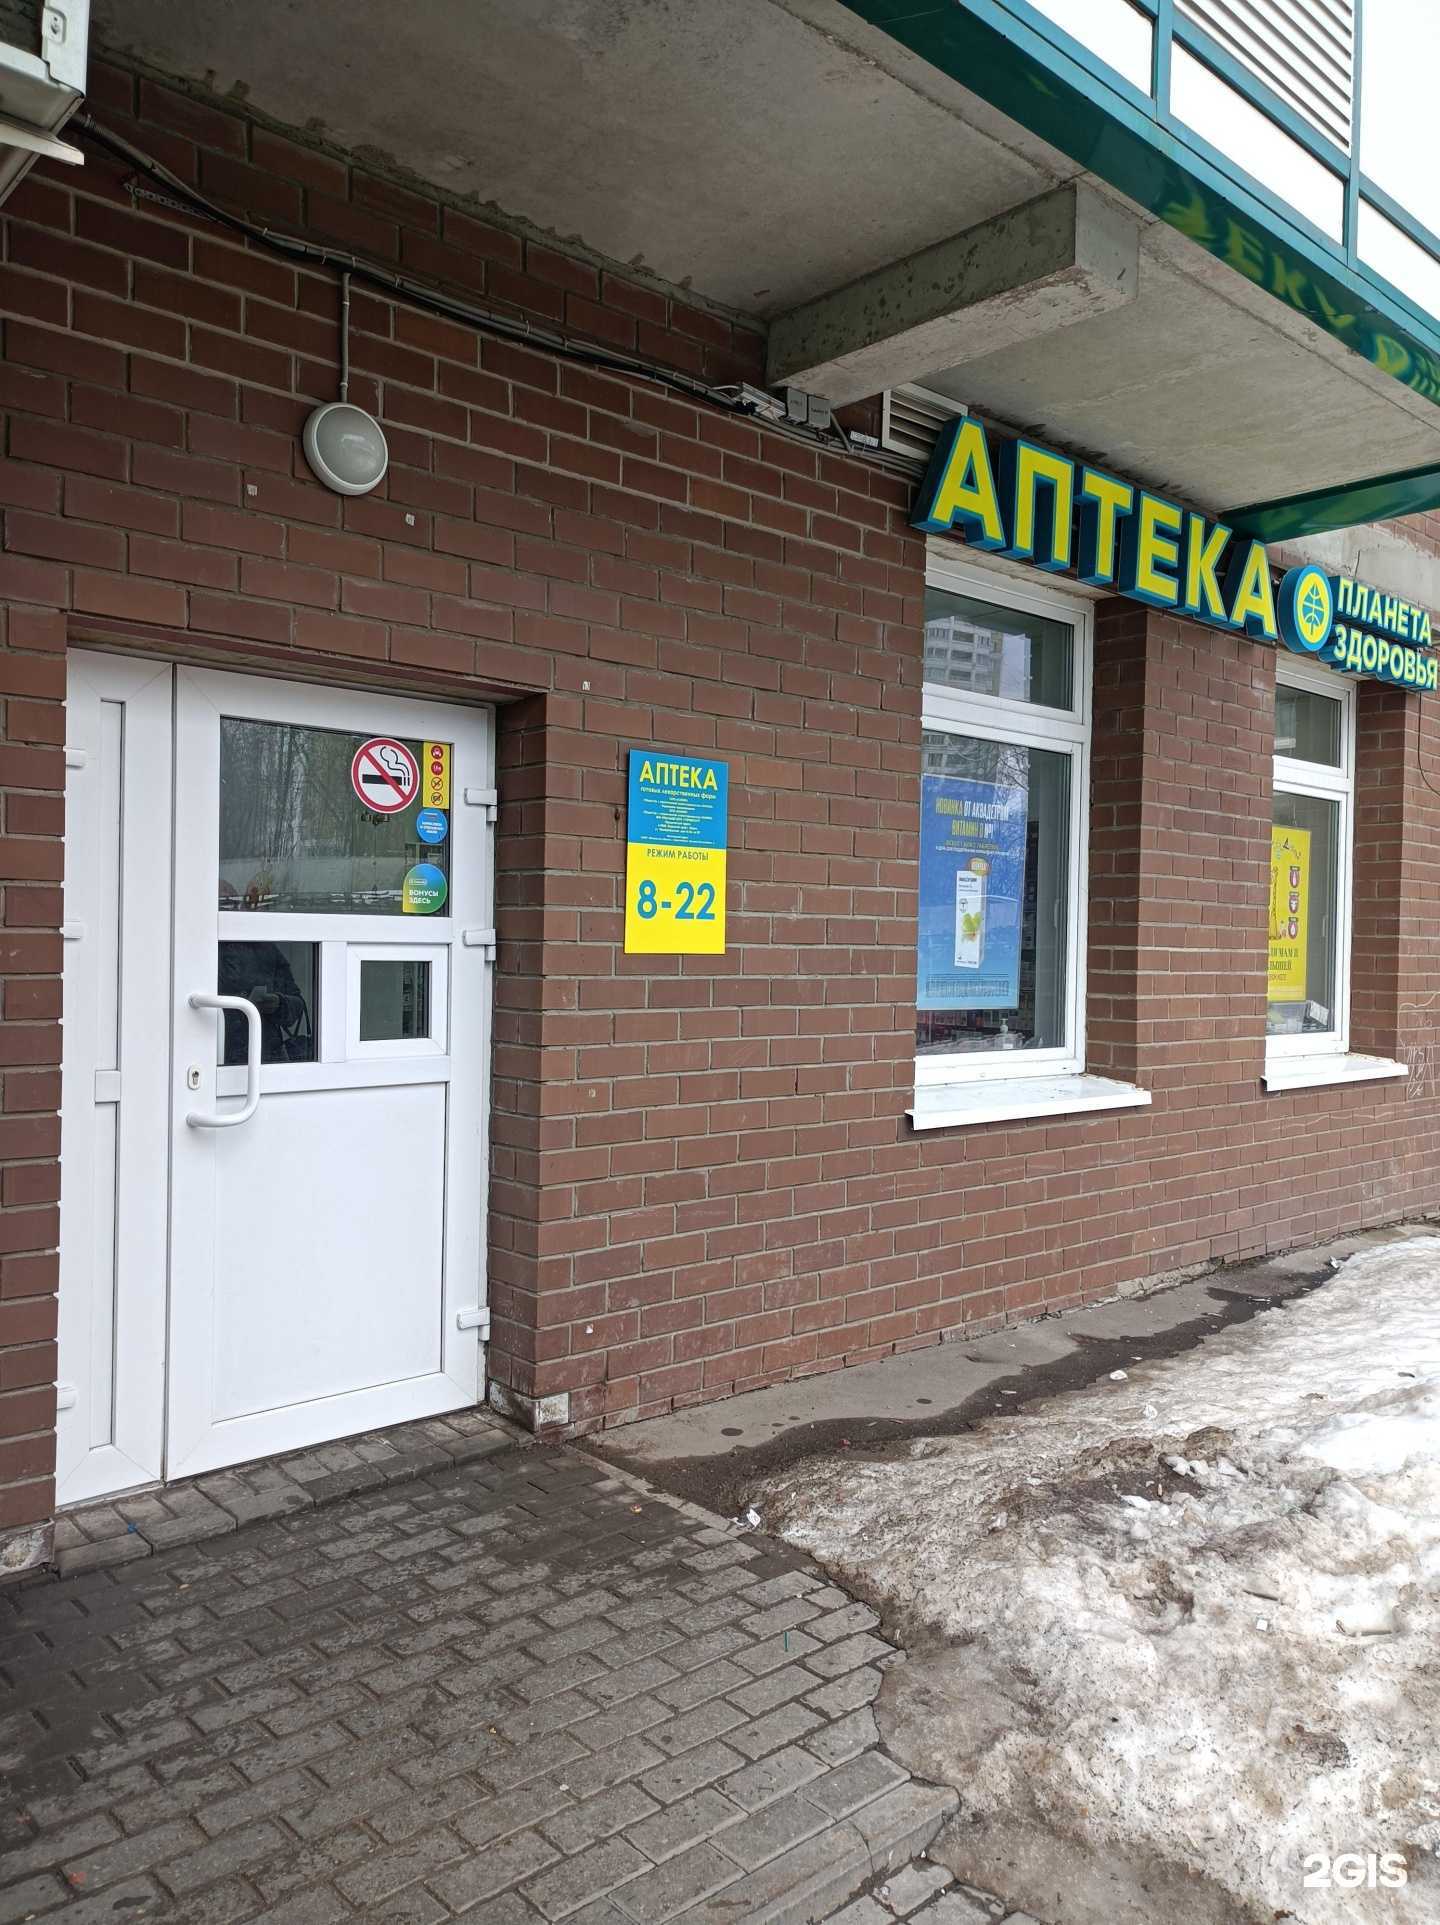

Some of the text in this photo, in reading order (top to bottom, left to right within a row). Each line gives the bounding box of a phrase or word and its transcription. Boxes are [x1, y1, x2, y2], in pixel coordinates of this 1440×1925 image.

[929, 416, 1279, 641] АПТЕКА
[1337, 576, 1432, 646] ПЛАНЕТА
[1334, 623, 1438, 691] ЗДОРОВЬЯ
[639, 759, 718, 791] АПТЕКА
[647, 848, 709, 861] РЕЖИМ РАБОТЫ
[408, 889, 439, 897] БОНУСЫ
[408, 897, 431, 905] ЗДЕСЬ
[637, 879, 716, 920] 8-22
